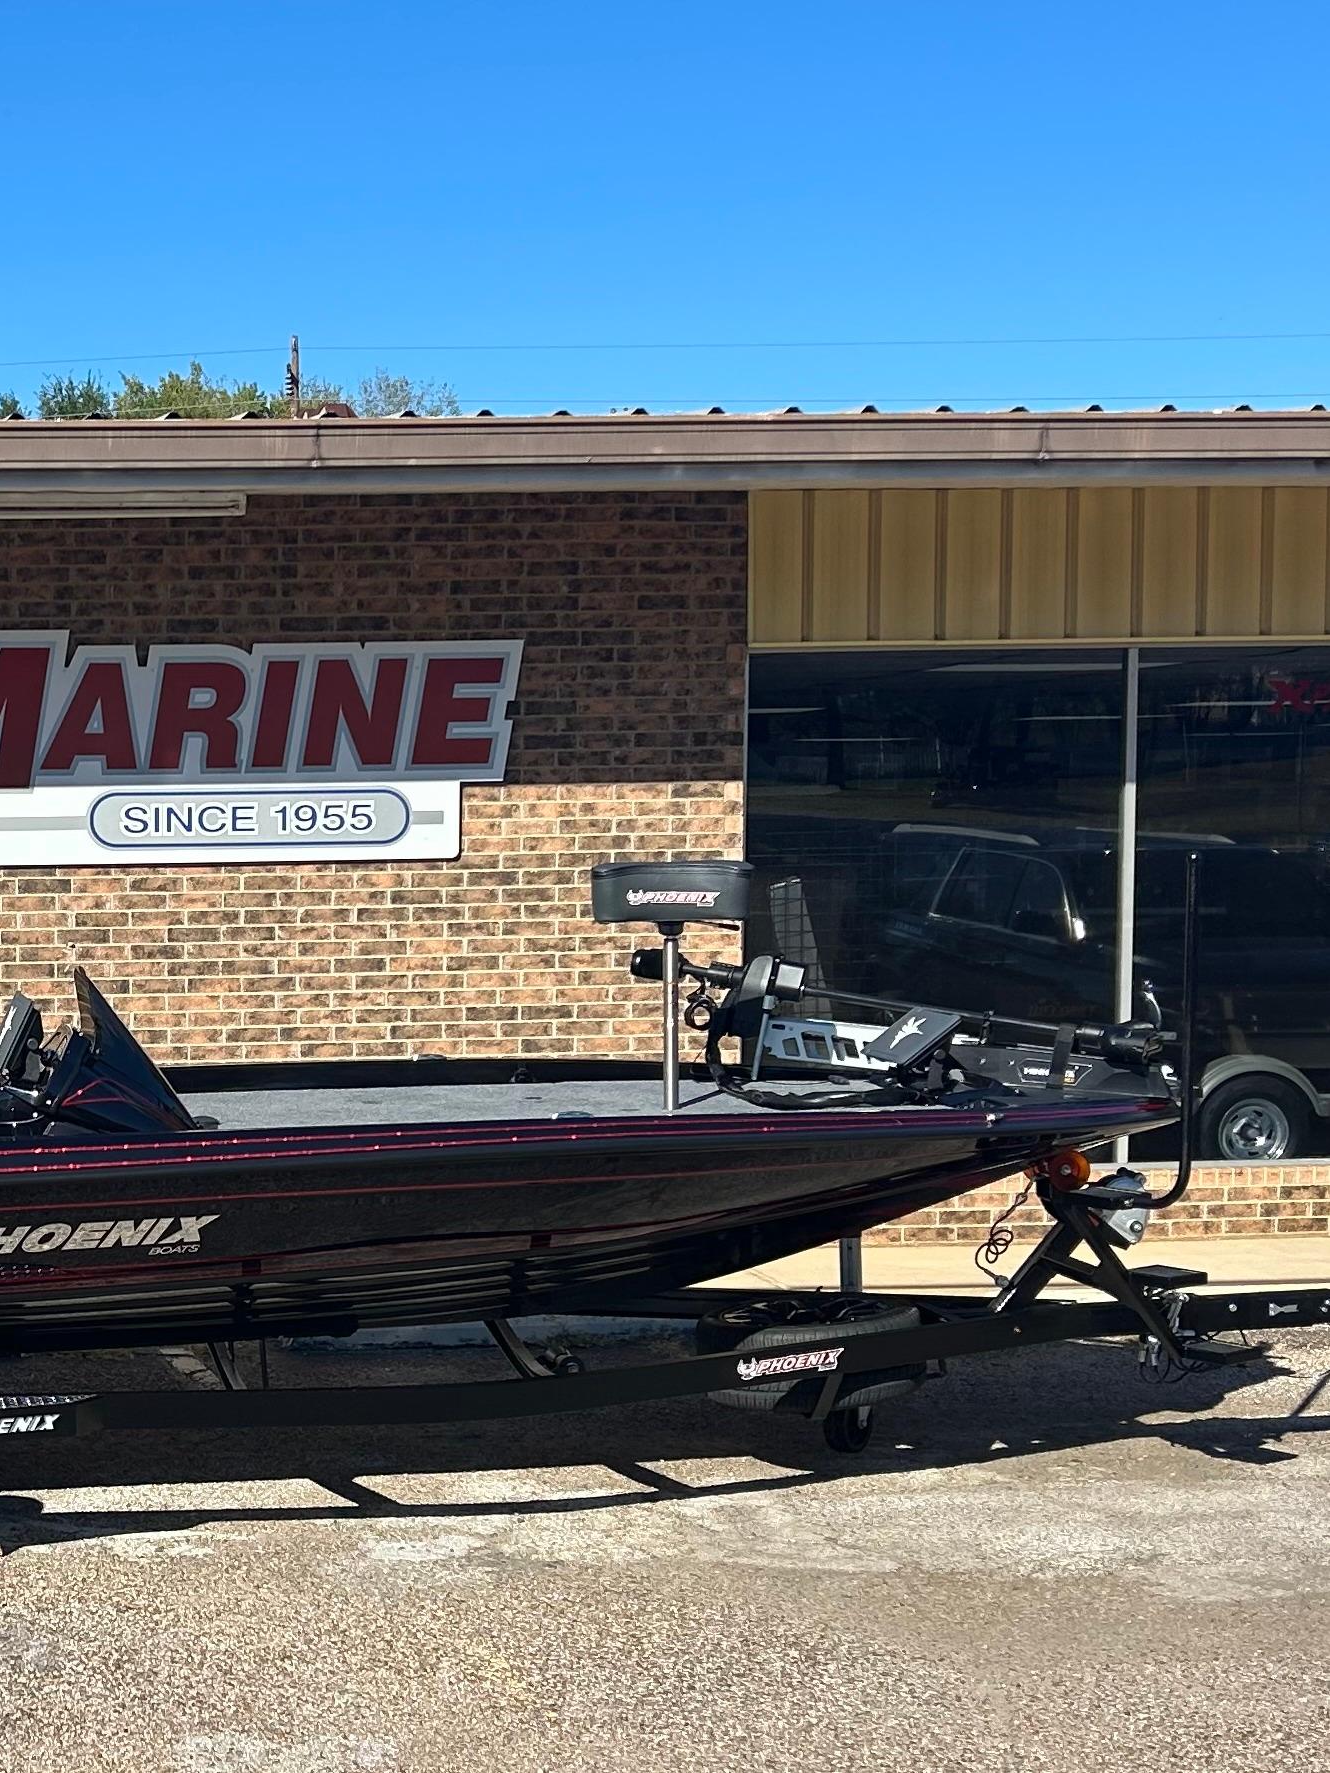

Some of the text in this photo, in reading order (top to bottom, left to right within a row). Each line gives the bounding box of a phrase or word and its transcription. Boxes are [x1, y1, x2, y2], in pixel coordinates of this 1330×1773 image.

[123, 803, 374, 833] SINCE 1955
[642, 891, 721, 904] PHOENIX
[148, 1244, 200, 1256] BOATS
[756, 1349, 843, 1375] PHOENIX
